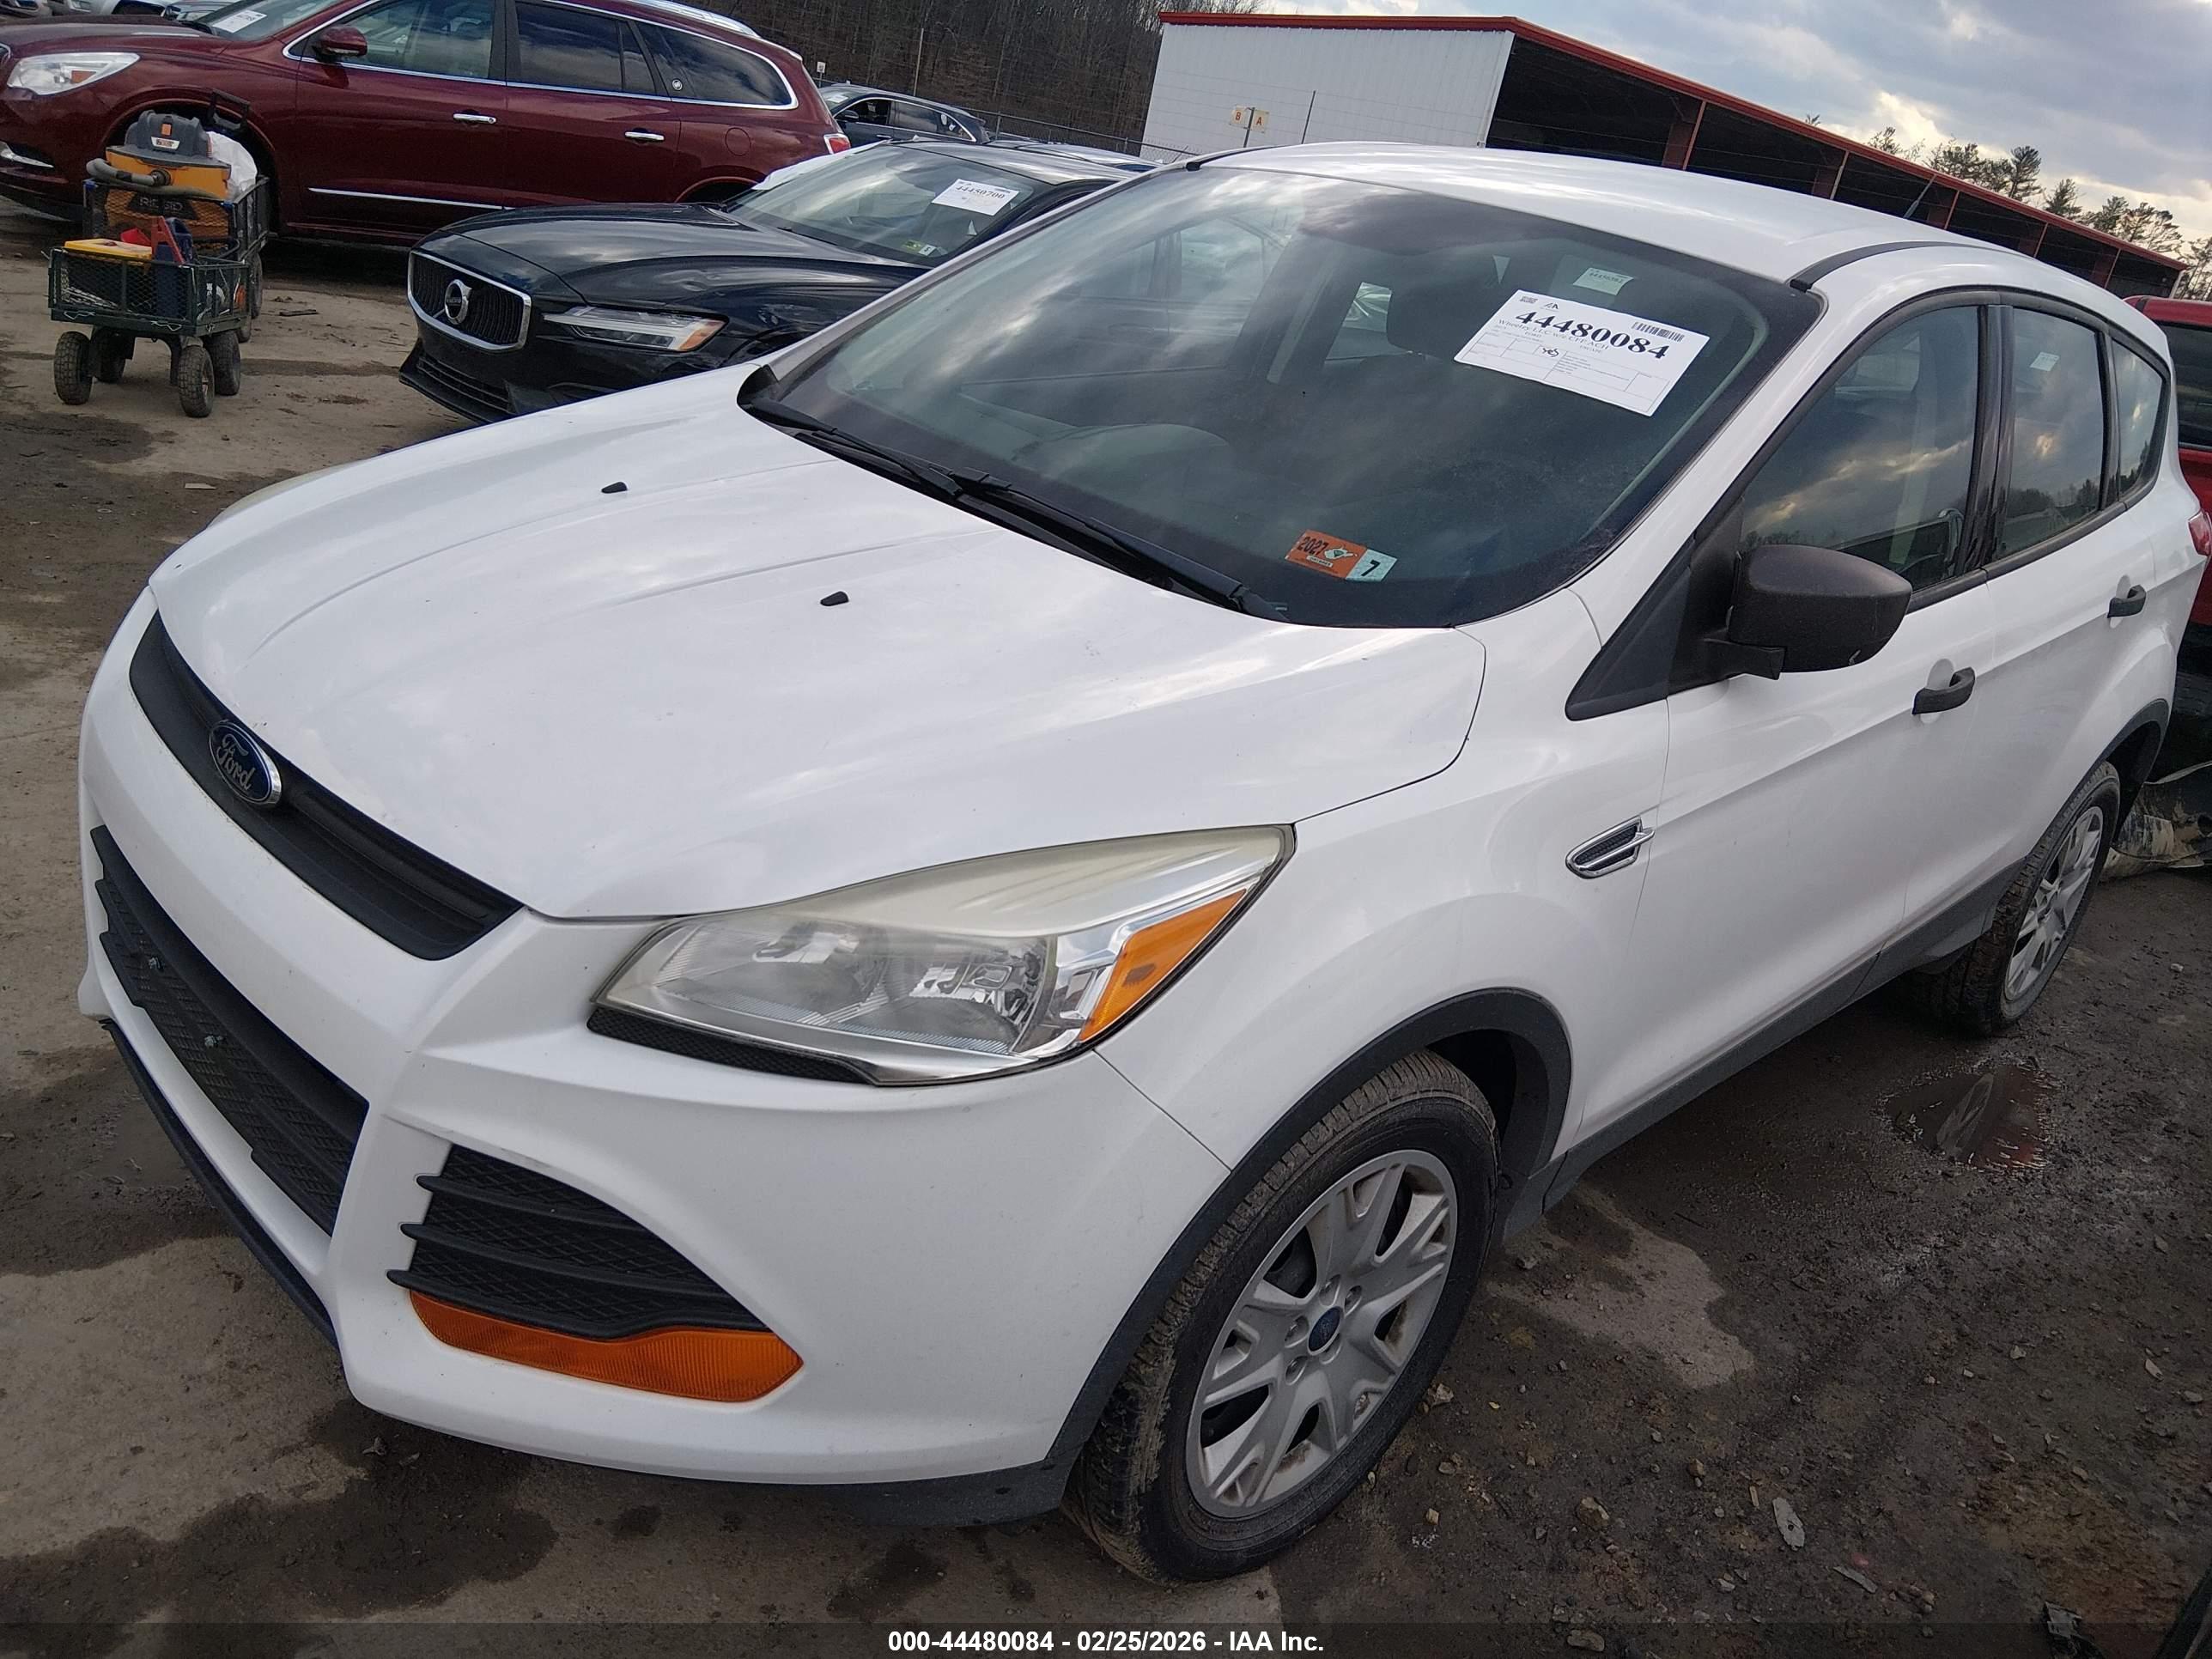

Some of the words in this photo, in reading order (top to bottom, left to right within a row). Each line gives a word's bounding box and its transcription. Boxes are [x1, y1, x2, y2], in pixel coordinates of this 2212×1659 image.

[1236, 112, 1241, 121] B
[1256, 117, 1262, 125] A
[1516, 311, 1670, 359] 44480084
[1297, 536, 1329, 555] 2027
[1361, 560, 1381, 576] 7
[216, 733, 256, 791] Ford
